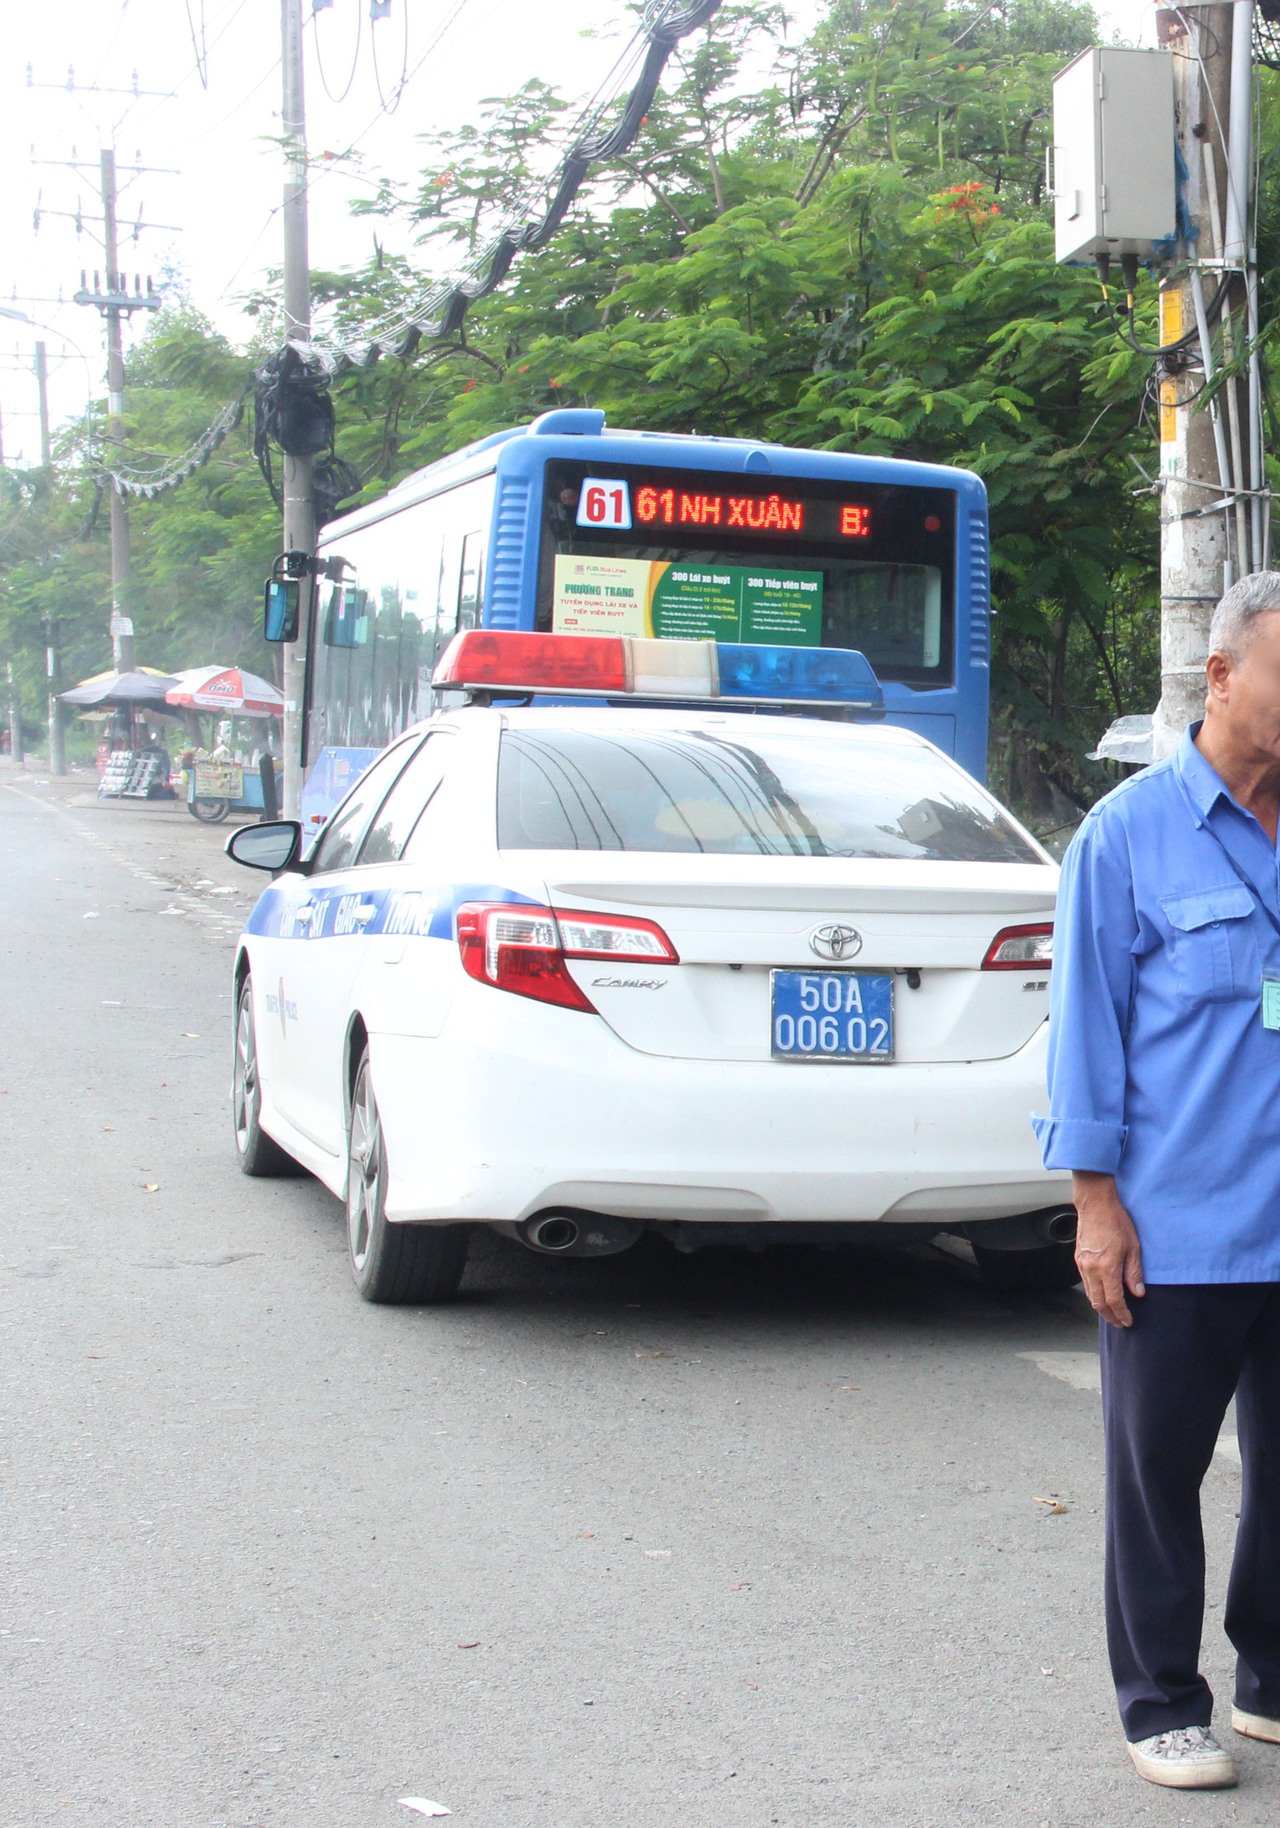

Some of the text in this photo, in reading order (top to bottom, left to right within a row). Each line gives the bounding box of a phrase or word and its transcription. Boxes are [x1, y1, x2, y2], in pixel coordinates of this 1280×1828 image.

[586, 487, 623, 524] 61
[637, 486, 674, 523] 61
[680, 494, 720, 524] NH
[728, 494, 802, 530] XUÂN
[672, 572, 688, 582] 300
[702, 575, 712, 583] xe
[747, 578, 764, 588] 300
[604, 586, 634, 598] TRANG
[207, 685, 235, 694] OMO
[591, 976, 669, 991] CAMRY
[1021, 980, 1049, 992] SE
[800, 975, 863, 1014] 50A
[775, 1014, 889, 1055] 006.02
